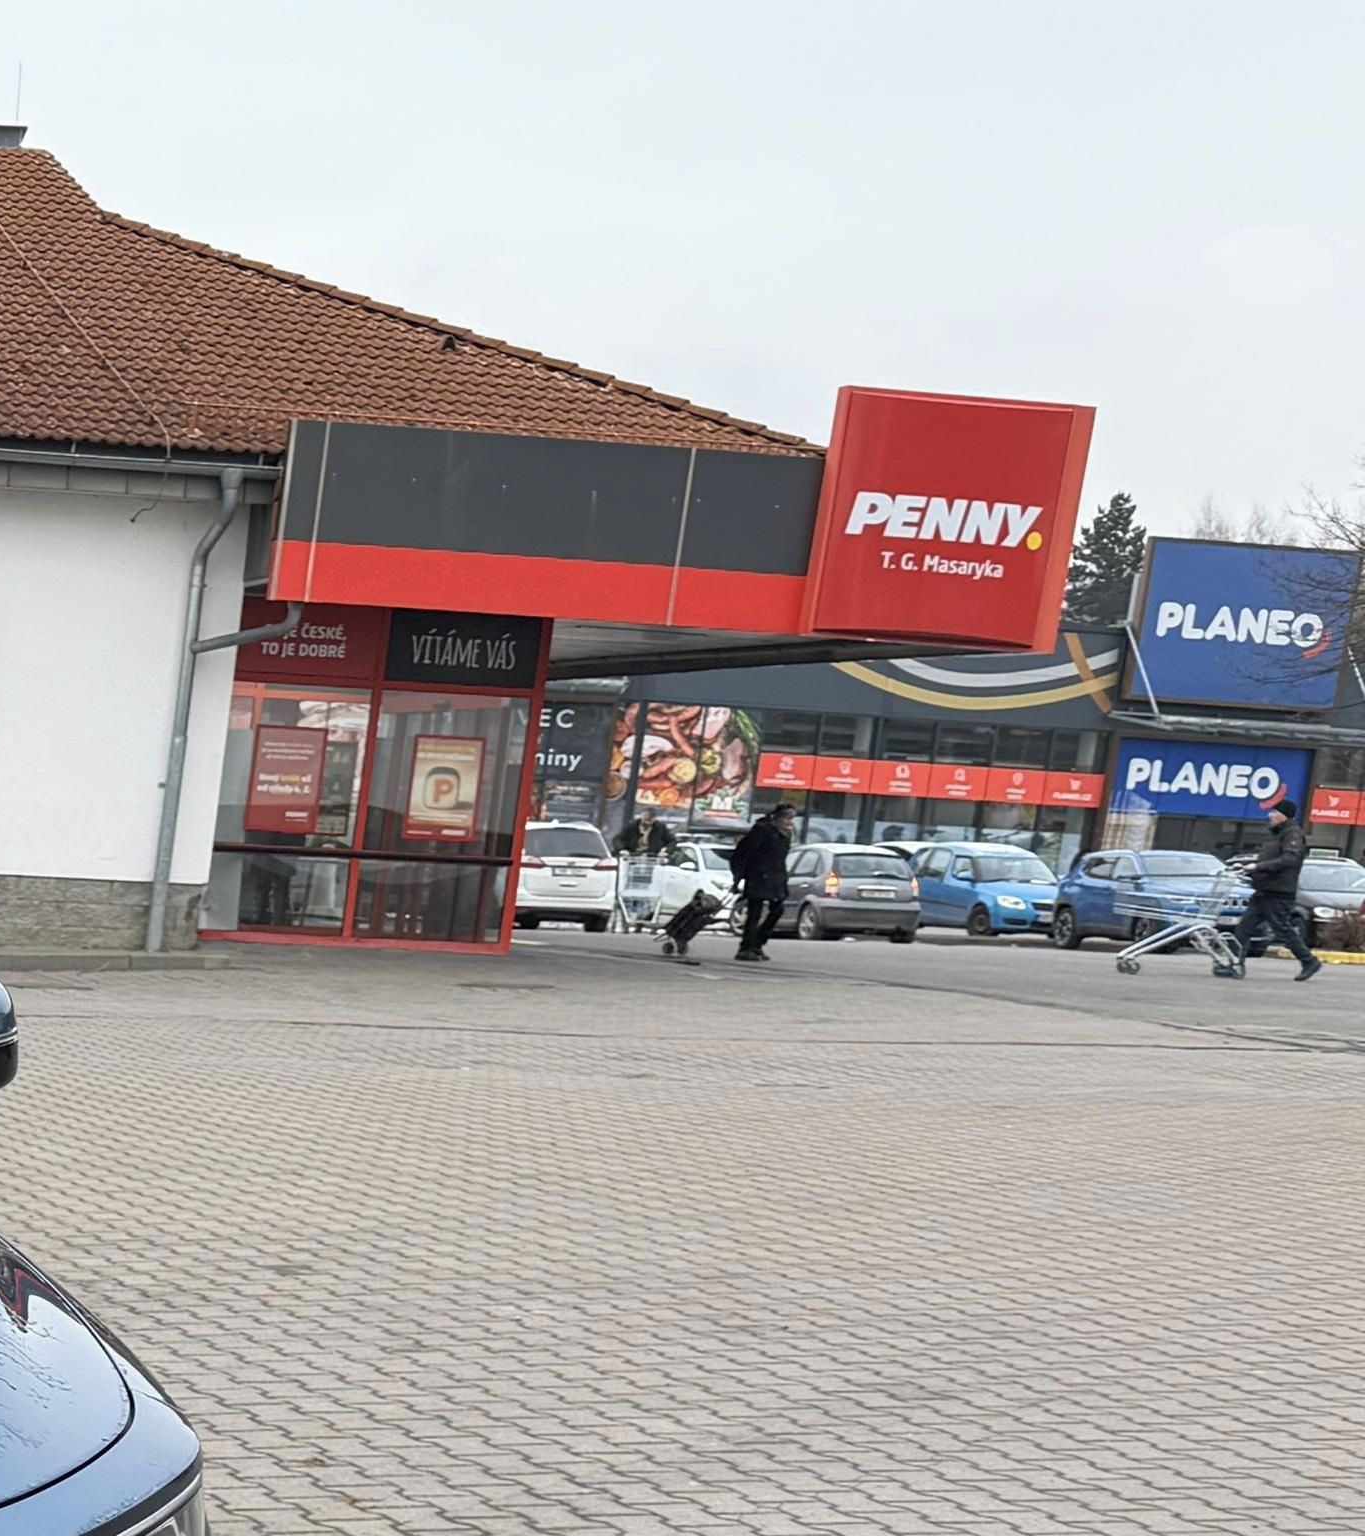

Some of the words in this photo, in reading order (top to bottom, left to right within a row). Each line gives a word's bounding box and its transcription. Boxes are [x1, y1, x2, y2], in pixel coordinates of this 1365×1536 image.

[881, 551, 896, 569] T.
[901, 553, 919, 571] G.
[923, 554, 1004, 580] Masaryka
[1156, 602, 1324, 648] PLANEO
[261, 641, 279, 655] TO
[280, 642, 296, 658] JE
[298, 642, 346, 658] DOBRÉ
[412, 628, 480, 668] VÍTÁME
[486, 633, 516, 670] VÁS
[1126, 758, 1280, 799] PLANEO
